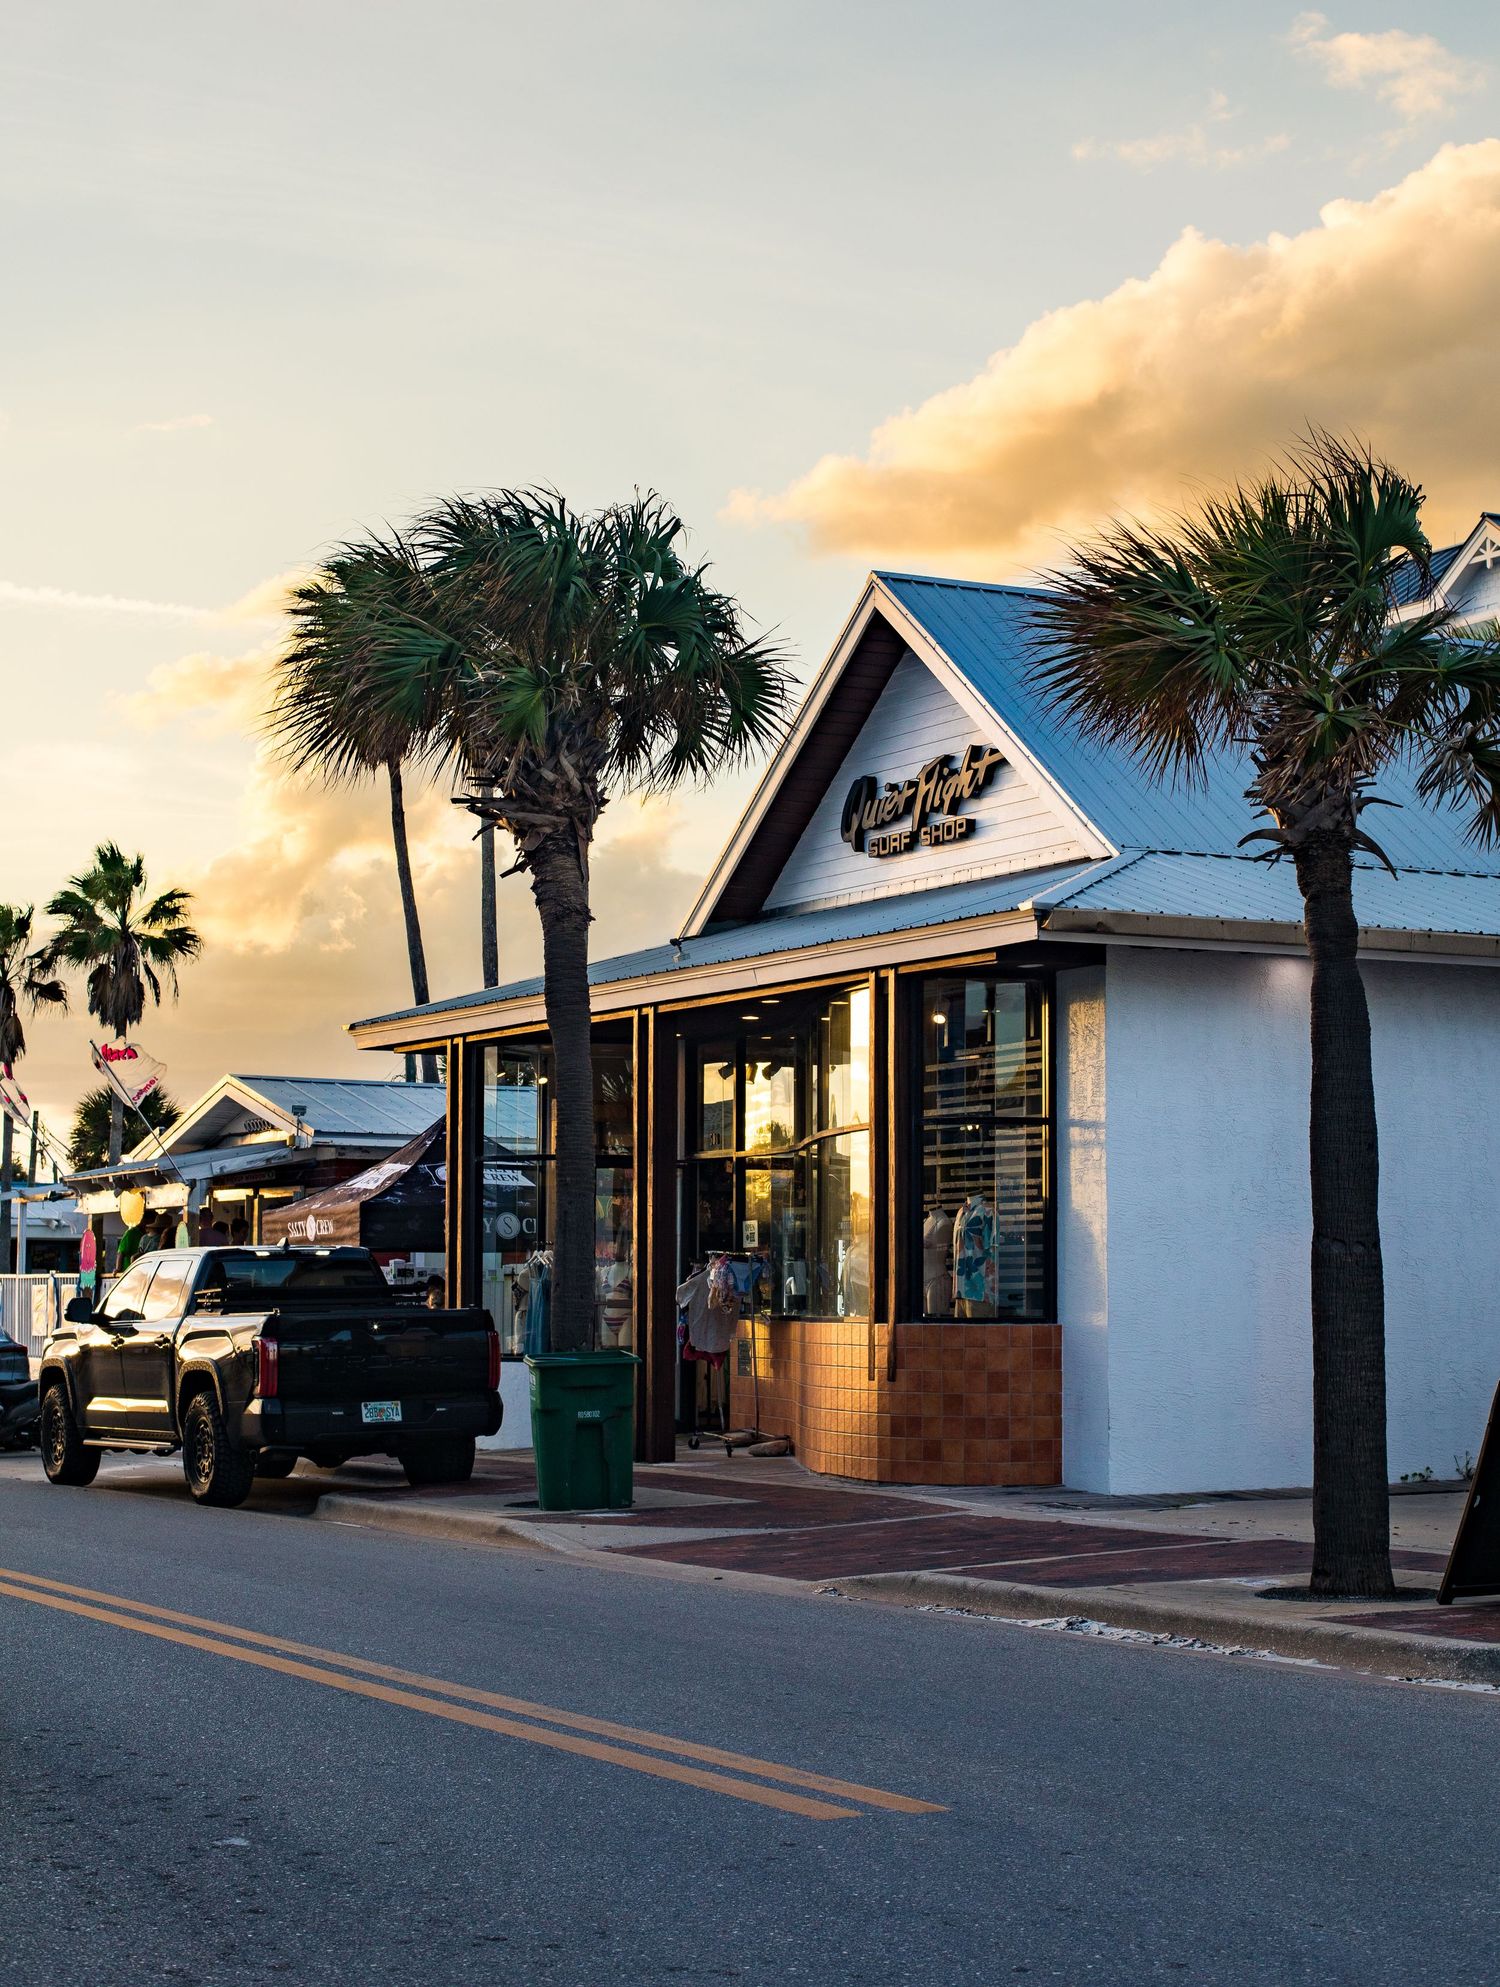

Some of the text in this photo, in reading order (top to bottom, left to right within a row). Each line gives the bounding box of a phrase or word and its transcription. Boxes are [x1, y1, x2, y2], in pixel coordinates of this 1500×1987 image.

[841, 745, 1008, 851] Quiet Flight
[868, 818, 974, 858] SURF SHOP
[287, 1221, 306, 1238] SALTY
[316, 1219, 333, 1235] CREW
